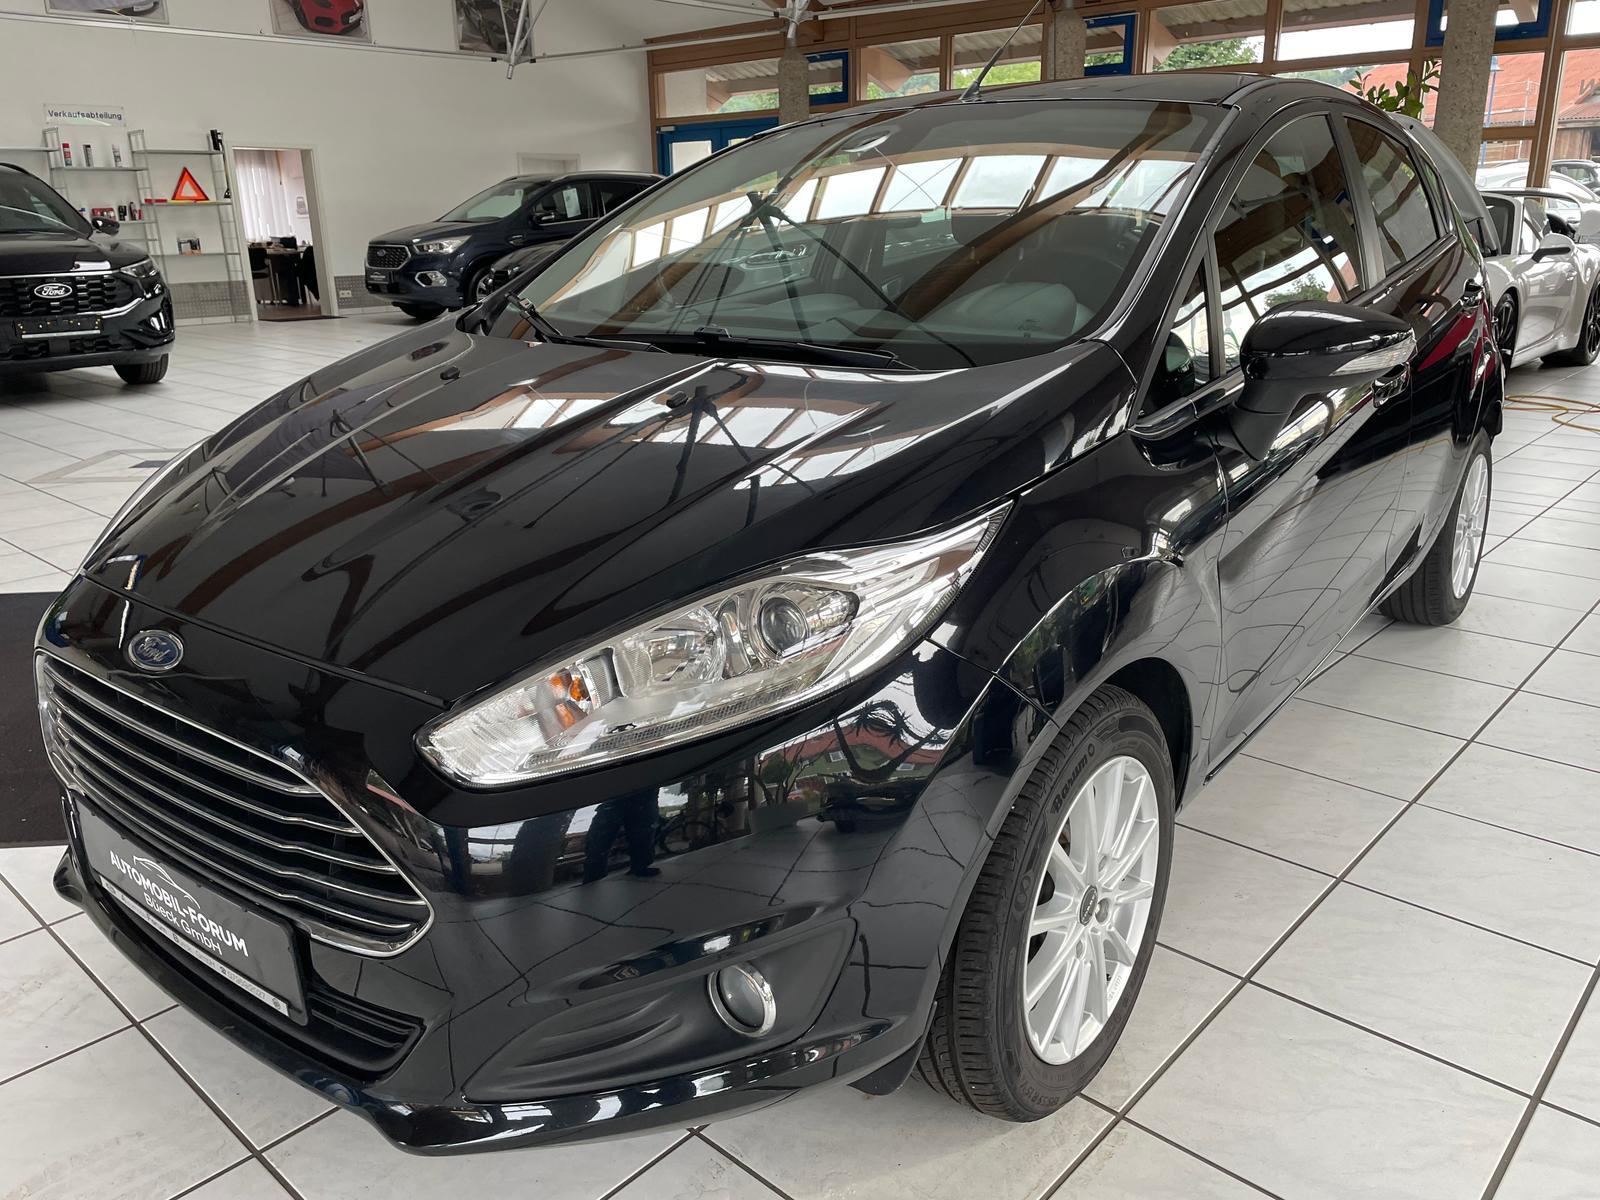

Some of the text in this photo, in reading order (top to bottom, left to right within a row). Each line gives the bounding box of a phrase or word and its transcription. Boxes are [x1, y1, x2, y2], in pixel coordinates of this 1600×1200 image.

[48, 110, 122, 121] Verkaufsabteilung
[41, 285, 66, 296] Ford
[110, 850, 249, 957] AUTOMOBIL-FORUM
[181, 919, 223, 956] GmbH
